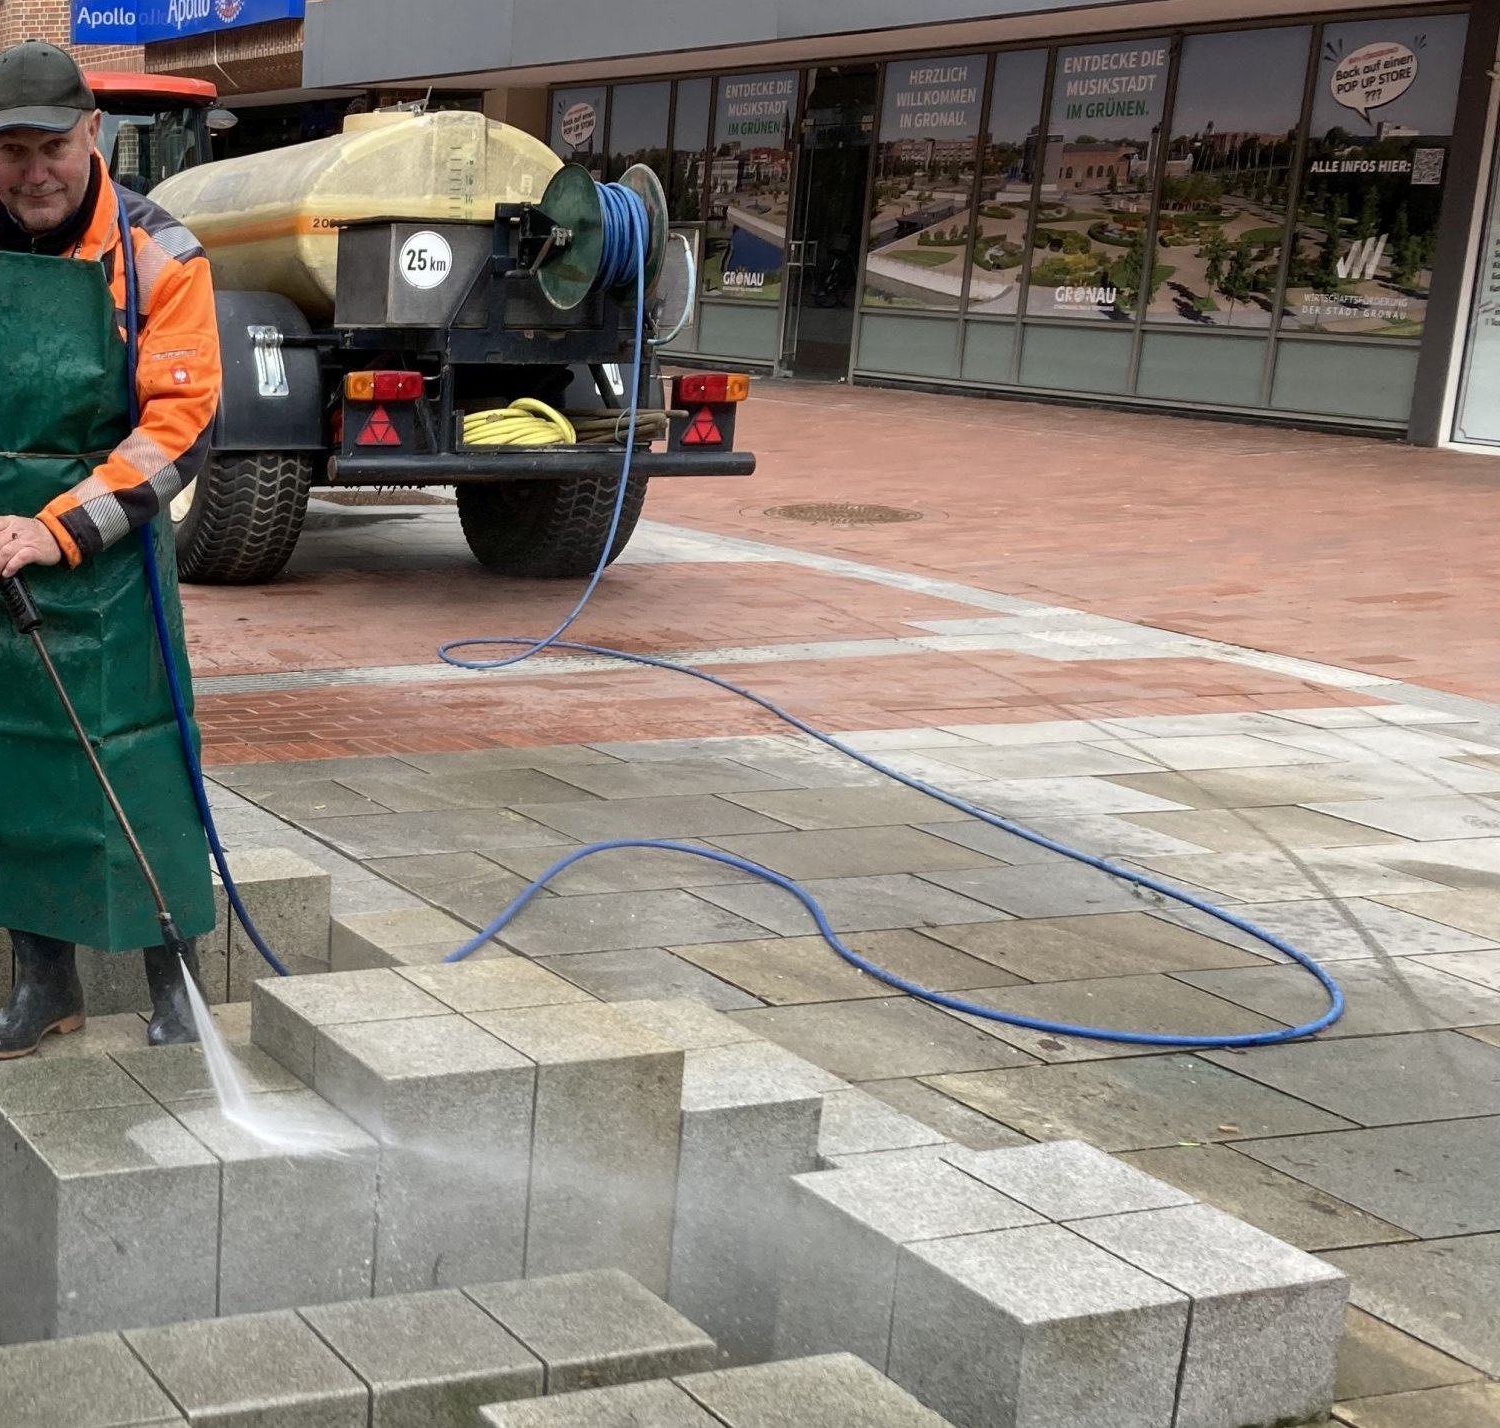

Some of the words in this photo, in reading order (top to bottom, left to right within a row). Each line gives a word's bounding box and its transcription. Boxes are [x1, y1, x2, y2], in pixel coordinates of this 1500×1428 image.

[77, 7, 136, 29] Apollo
[167, 0, 210, 30] Apollo
[1062, 51, 1139, 74] ENTDECKE
[1141, 49, 1166, 68] DIE
[1336, 64, 1360, 81] Bock
[1363, 59, 1381, 74] auf
[1384, 54, 1413, 69] einen
[909, 66, 968, 85] HERZLICH
[1337, 80, 1359, 94] POP
[1361, 75, 1377, 89] UP
[1379, 67, 1412, 85] STORE
[725, 83, 776, 98] ENTDECKE
[777, 80, 793, 94] DIE
[1066, 75, 1157, 96] MUSIKSTADT
[1364, 88, 1383, 101] ???
[896, 87, 977, 107] WILLKOMMEN
[728, 100, 788, 117] MUSIKSTADT
[1066, 103, 1082, 119] IM
[1086, 98, 1149, 118] GRÜNEN.
[728, 122, 739, 135] IM
[900, 113, 912, 129] IN
[914, 111, 967, 127] GRONAU.
[1310, 161, 1339, 173] ALLE
[1341, 161, 1376, 173] INFOS
[1378, 161, 1412, 173] HIER:
[406, 248, 428, 271] 25
[430, 258, 446, 271] km
[723, 271, 765, 286] GRONAU
[1055, 286, 1117, 304] GRONAU
[1301, 305, 1321, 314] DER
[1325, 306, 1358, 316] STADT
[1363, 309, 1407, 320] GRONAU
